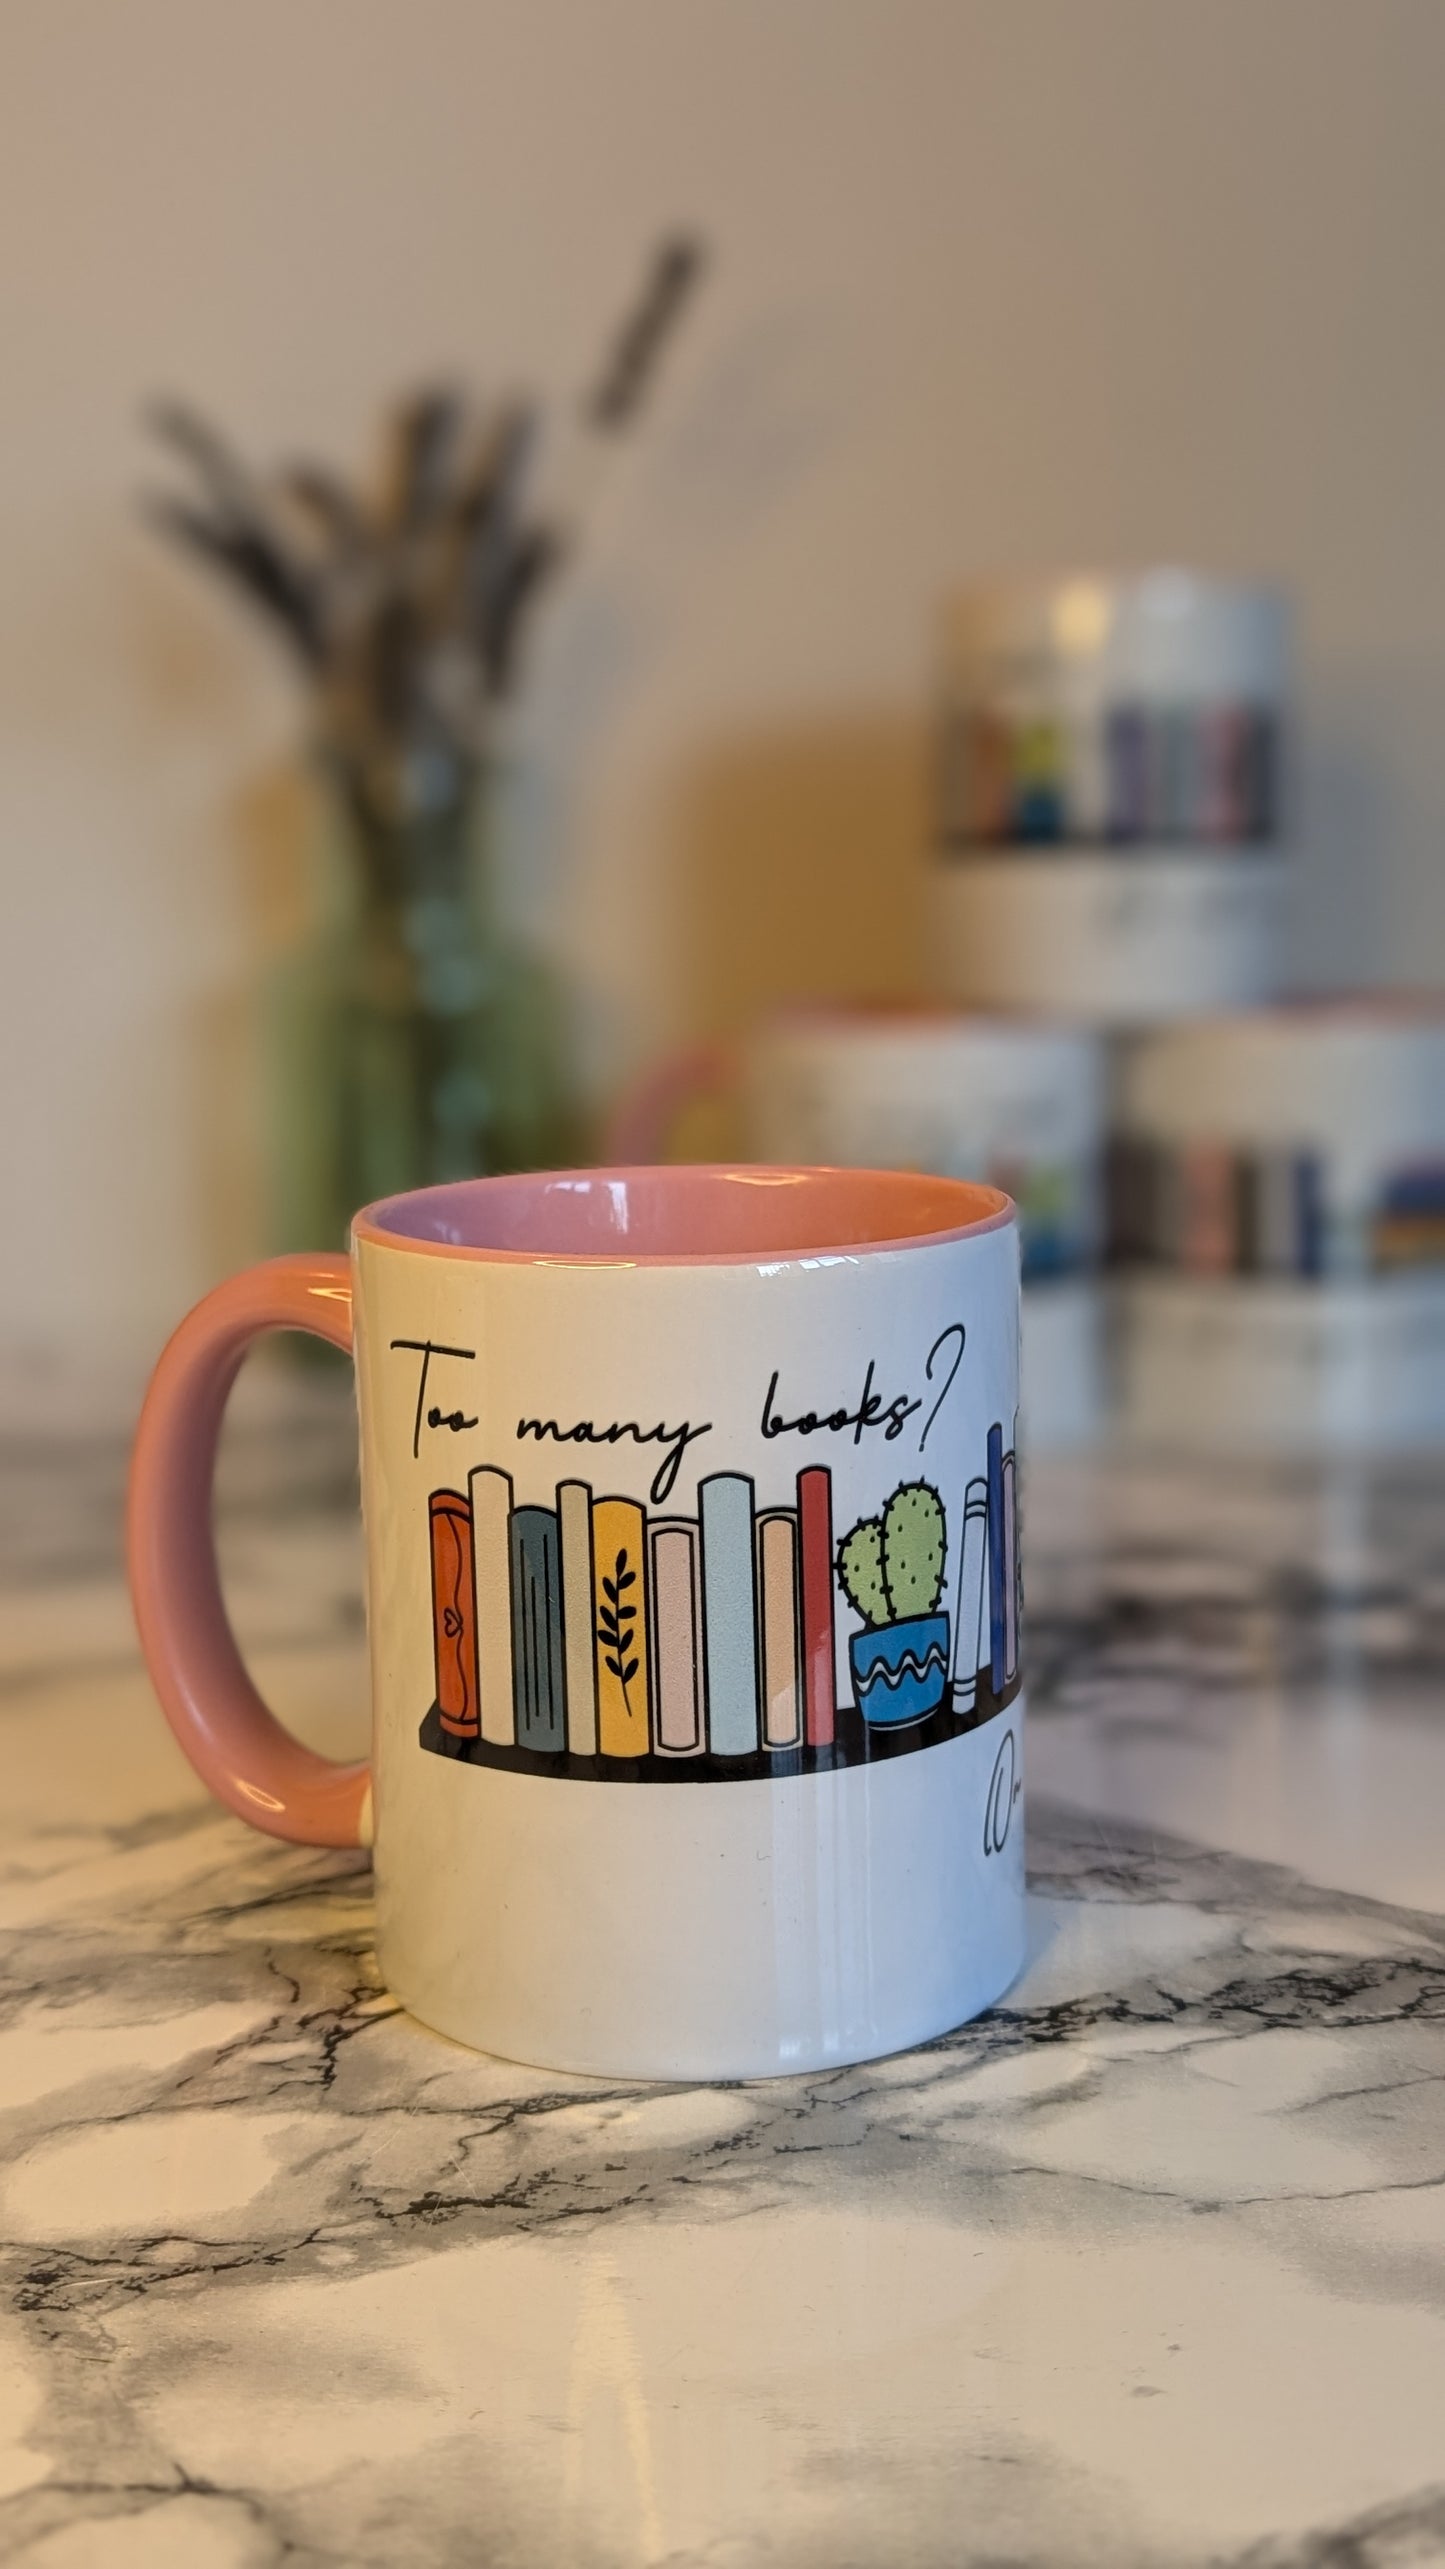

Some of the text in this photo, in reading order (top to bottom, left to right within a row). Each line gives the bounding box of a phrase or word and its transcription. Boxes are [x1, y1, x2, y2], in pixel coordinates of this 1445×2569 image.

[390, 1323, 966, 1504] Too many books?
